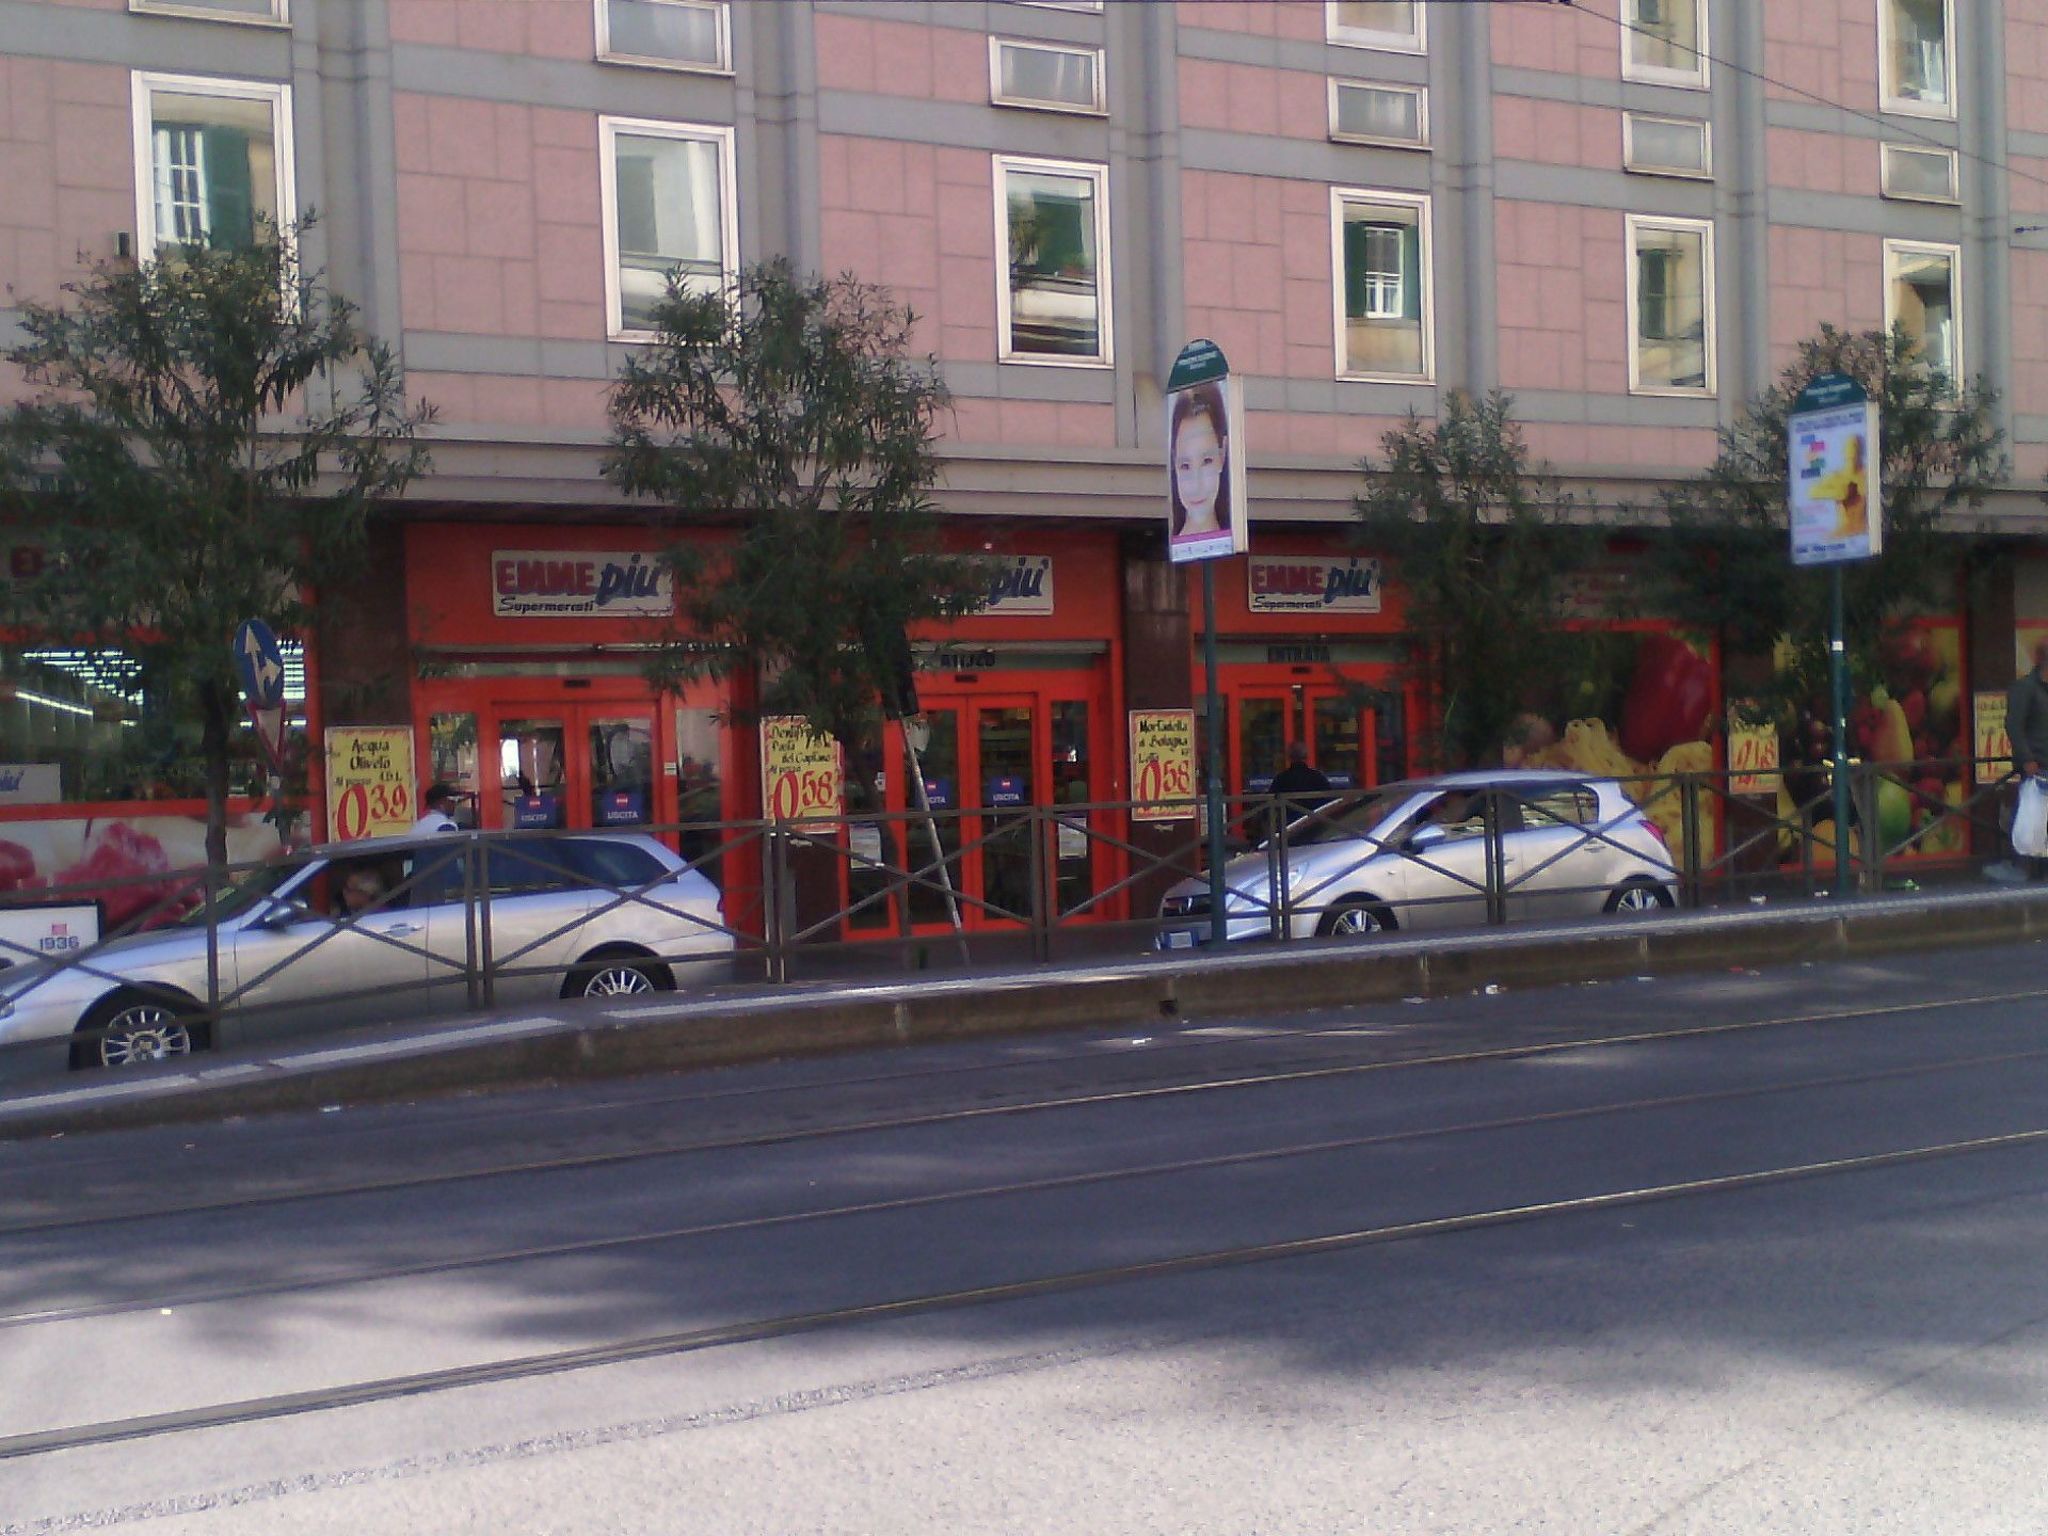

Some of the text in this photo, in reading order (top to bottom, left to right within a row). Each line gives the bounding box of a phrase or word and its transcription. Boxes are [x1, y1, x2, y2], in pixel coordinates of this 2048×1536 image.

[496, 561, 597, 596] EMME
[1252, 565, 1326, 595] EMME
[499, 597, 594, 614] Supermercati
[352, 739, 390, 755] Acqua
[607, 810, 638, 819] USCITA
